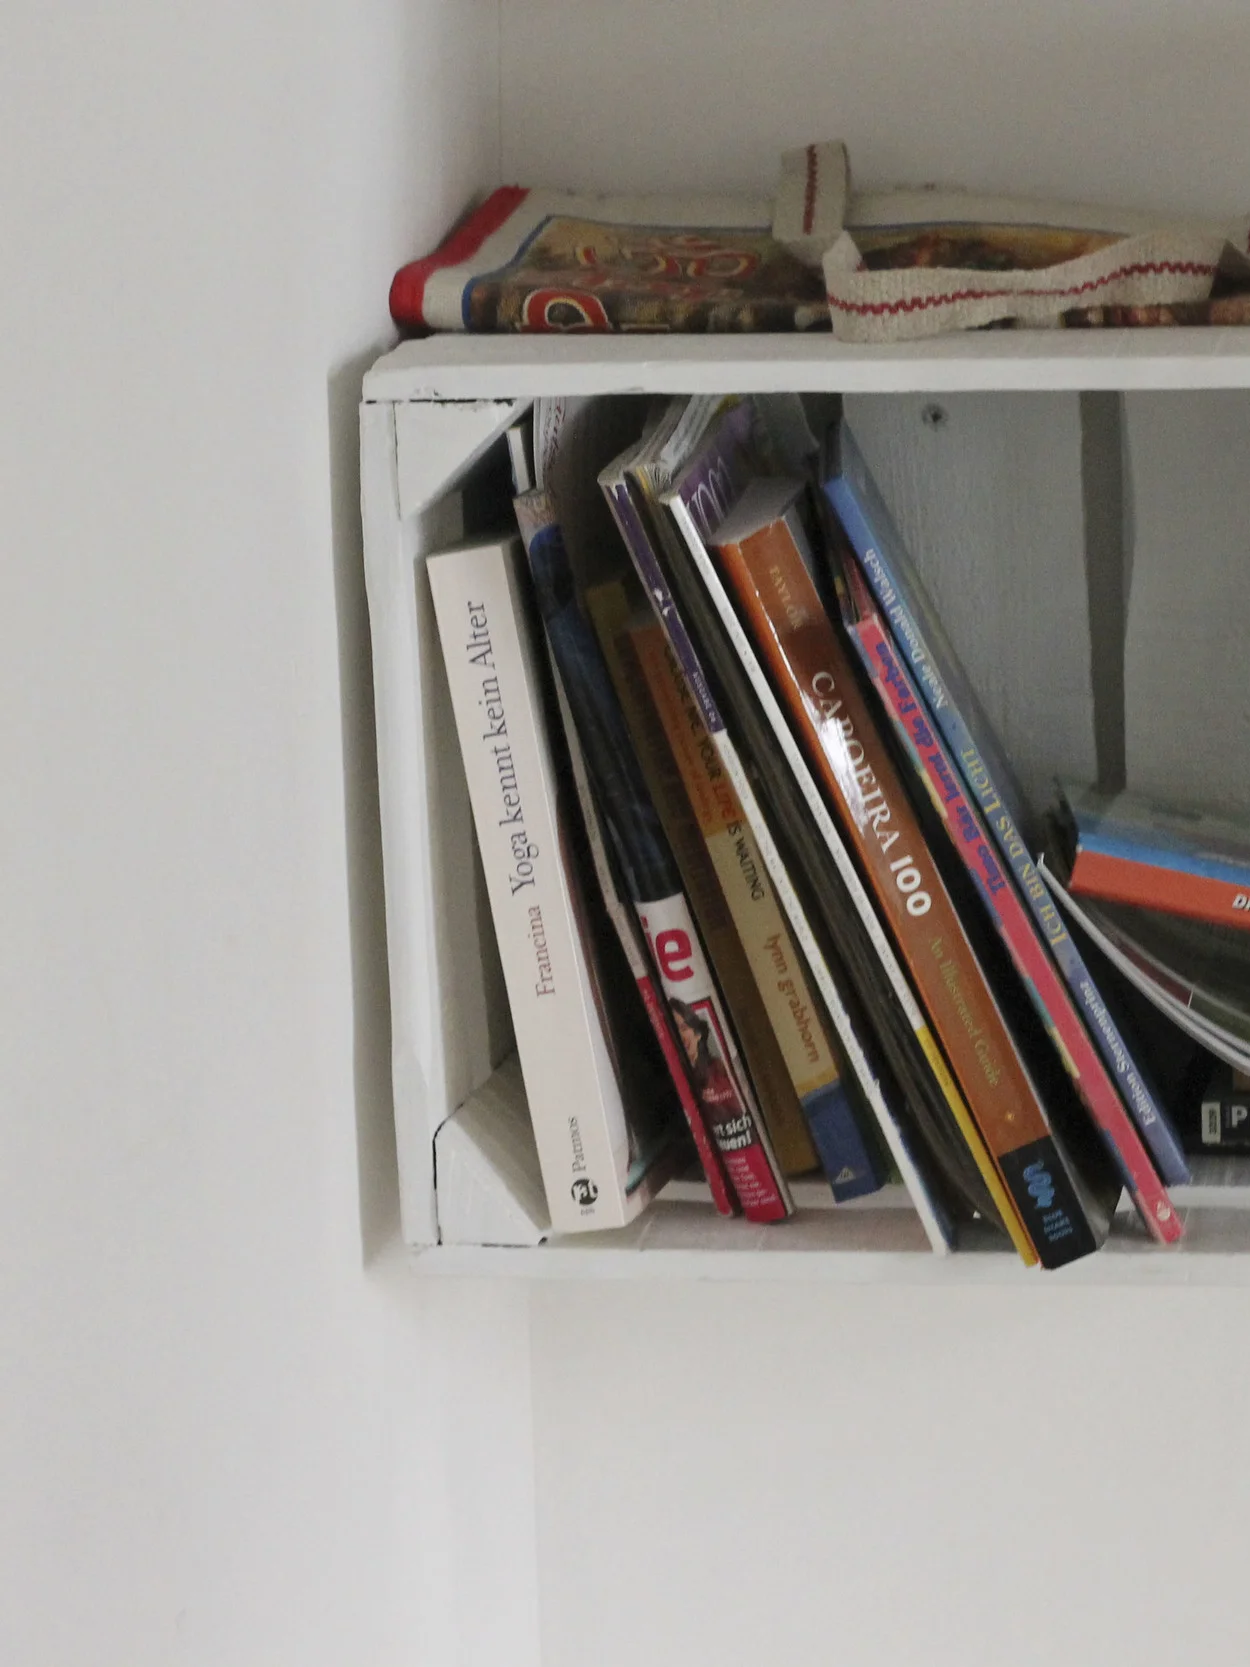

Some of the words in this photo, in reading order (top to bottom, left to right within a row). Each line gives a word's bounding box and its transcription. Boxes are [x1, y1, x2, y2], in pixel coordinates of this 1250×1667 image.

[864, 548, 896, 606] Walsch
[465, 600, 496, 670] Alter
[889, 604, 925, 665] Donald
[478, 675, 508, 742] kein
[921, 662, 949, 710] Neale
[491, 742, 524, 827] kennt
[726, 819, 743, 838] IS
[509, 830, 540, 896] Yoga
[734, 836, 765, 901] WAITING
[888, 854, 933, 919] 100
[528, 904, 556, 998] Francina
[763, 932, 788, 975] lynn
[777, 978, 820, 1063] grabhorn
[725, 1114, 752, 1136] sich
[1126, 1071, 1157, 1127] Edition
[568, 1115, 587, 1173] Patmos
